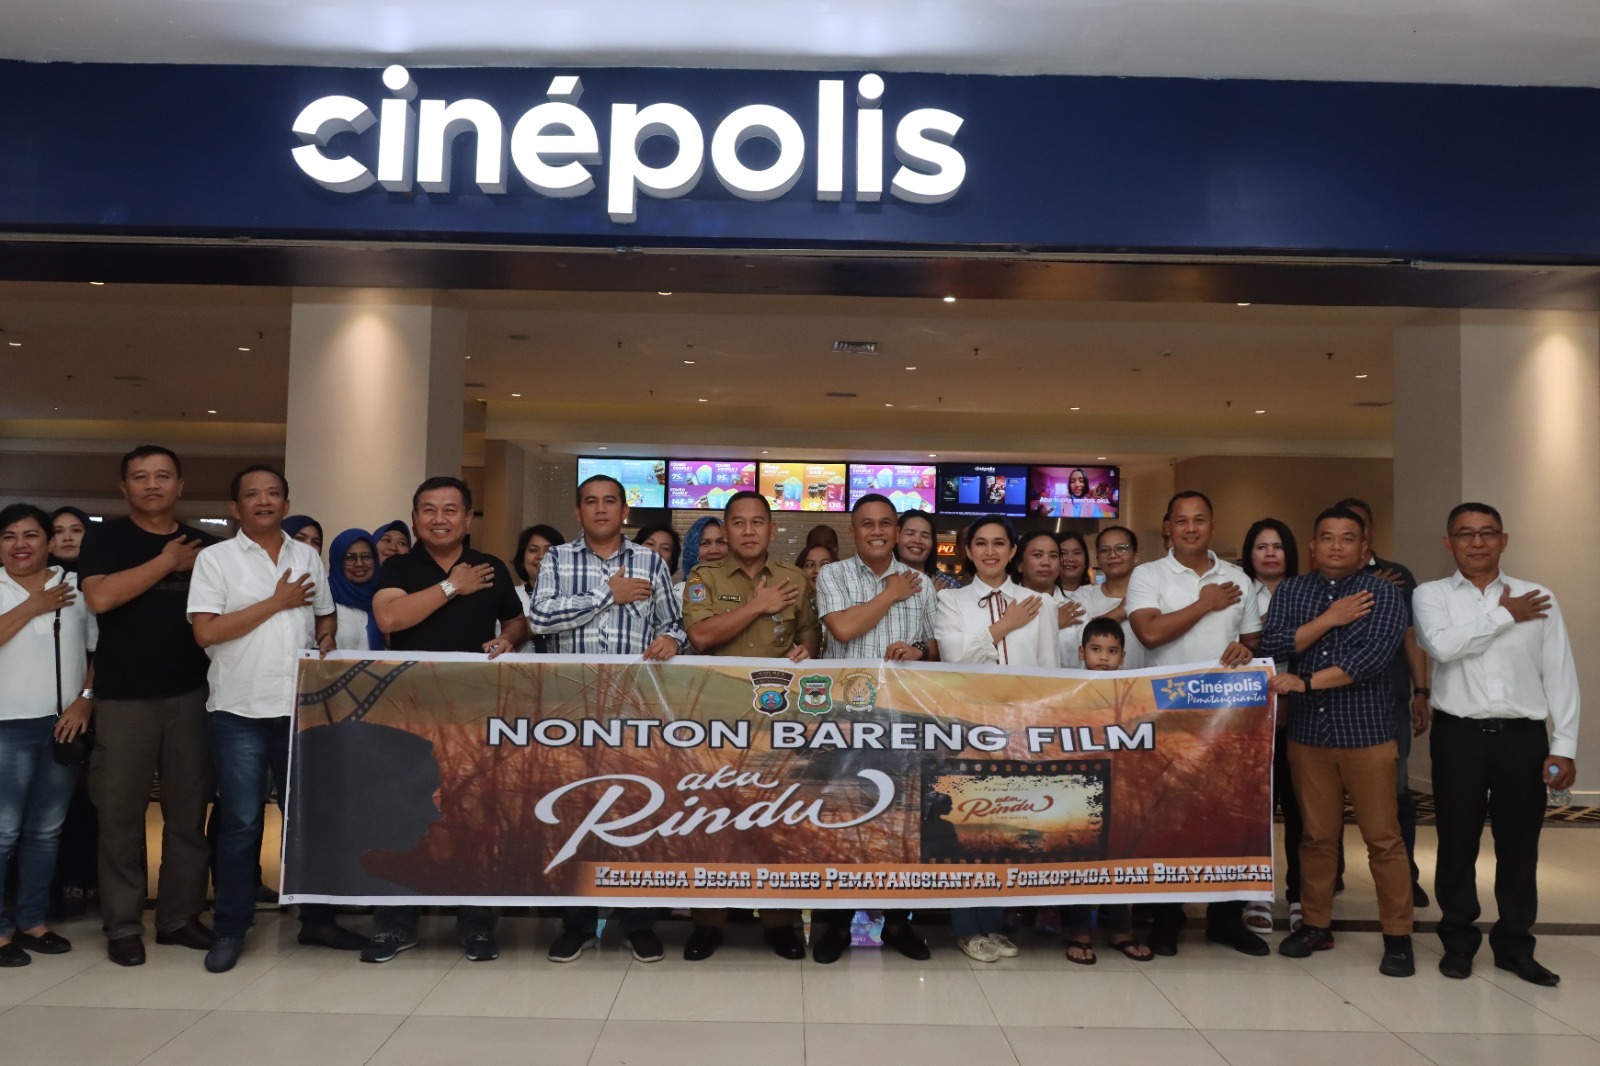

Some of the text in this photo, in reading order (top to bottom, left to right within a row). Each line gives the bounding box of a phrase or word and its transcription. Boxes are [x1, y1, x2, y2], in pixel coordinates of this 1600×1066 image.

[291, 64, 968, 224] cinépolis
[1187, 678, 1262, 696] Cinépolis
[487, 717, 1154, 753] NONTON BARENG FILM
[677, 765, 780, 791] aku
[535, 768, 895, 875] Rindu
[957, 795, 1054, 822] Rindu
[694, 867, 752, 889] BESAR
[757, 868, 821, 890] POLRES
[1113, 866, 1150, 886] DAN
